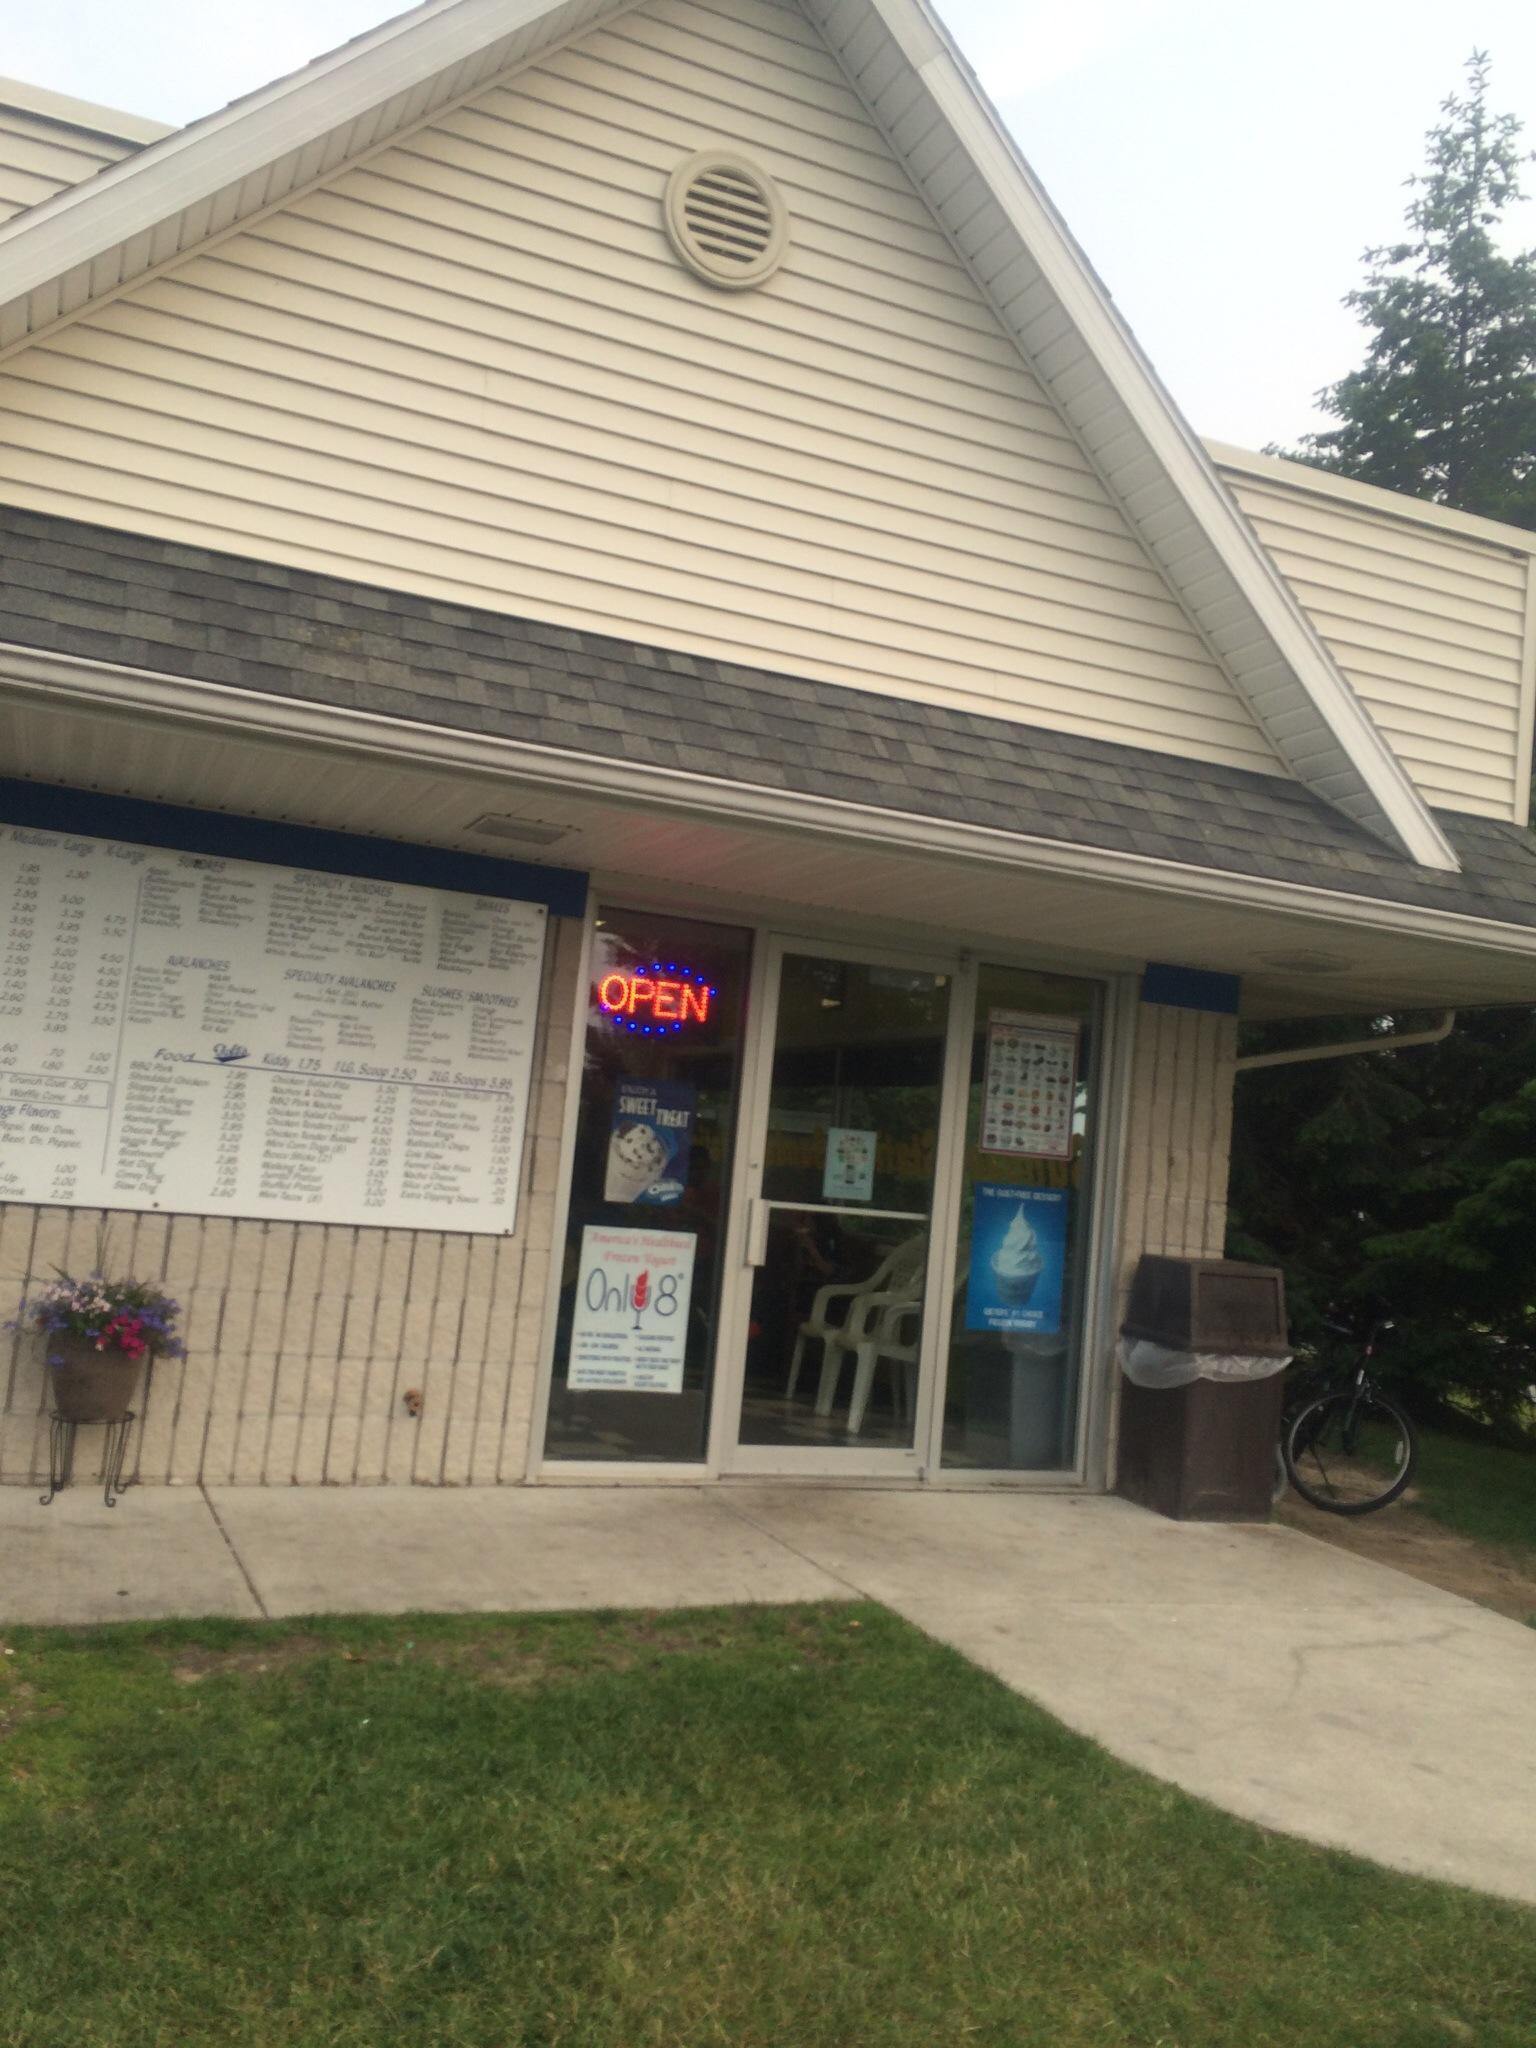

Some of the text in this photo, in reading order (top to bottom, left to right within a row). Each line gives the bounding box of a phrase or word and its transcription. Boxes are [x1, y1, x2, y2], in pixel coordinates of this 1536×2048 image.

[10, 830, 58, 848] Medium
[63, 839, 96, 857] Large
[284, 968, 397, 993] SPECIALTY AVALANCHES
[599, 974, 710, 1023] OPEN
[153, 1047, 197, 1063] Food
[262, 1053, 321, 1071] Kiddy 1.75
[358, 1062, 389, 1079] Scoop
[389, 1066, 417, 1080] 2.50
[173, 1075, 209, 1087] Chicken
[271, 1075, 305, 1085] Chicken
[452, 1072, 488, 1089] Scoops
[159, 1084, 177, 1094] Joe
[155, 1105, 192, 1116] Chicken
[266, 1106, 301, 1118] Chicken
[619, 1096, 691, 1128] SWEET TREAT
[265, 1116, 300, 1127] Chicken
[155, 1128, 187, 1140] Burger
[264, 1127, 299, 1139] Chicken
[150, 1137, 181, 1150] Burger
[135, 1159, 156, 1173] Dog
[603, 1251, 678, 1268] Frozen Yogurt
